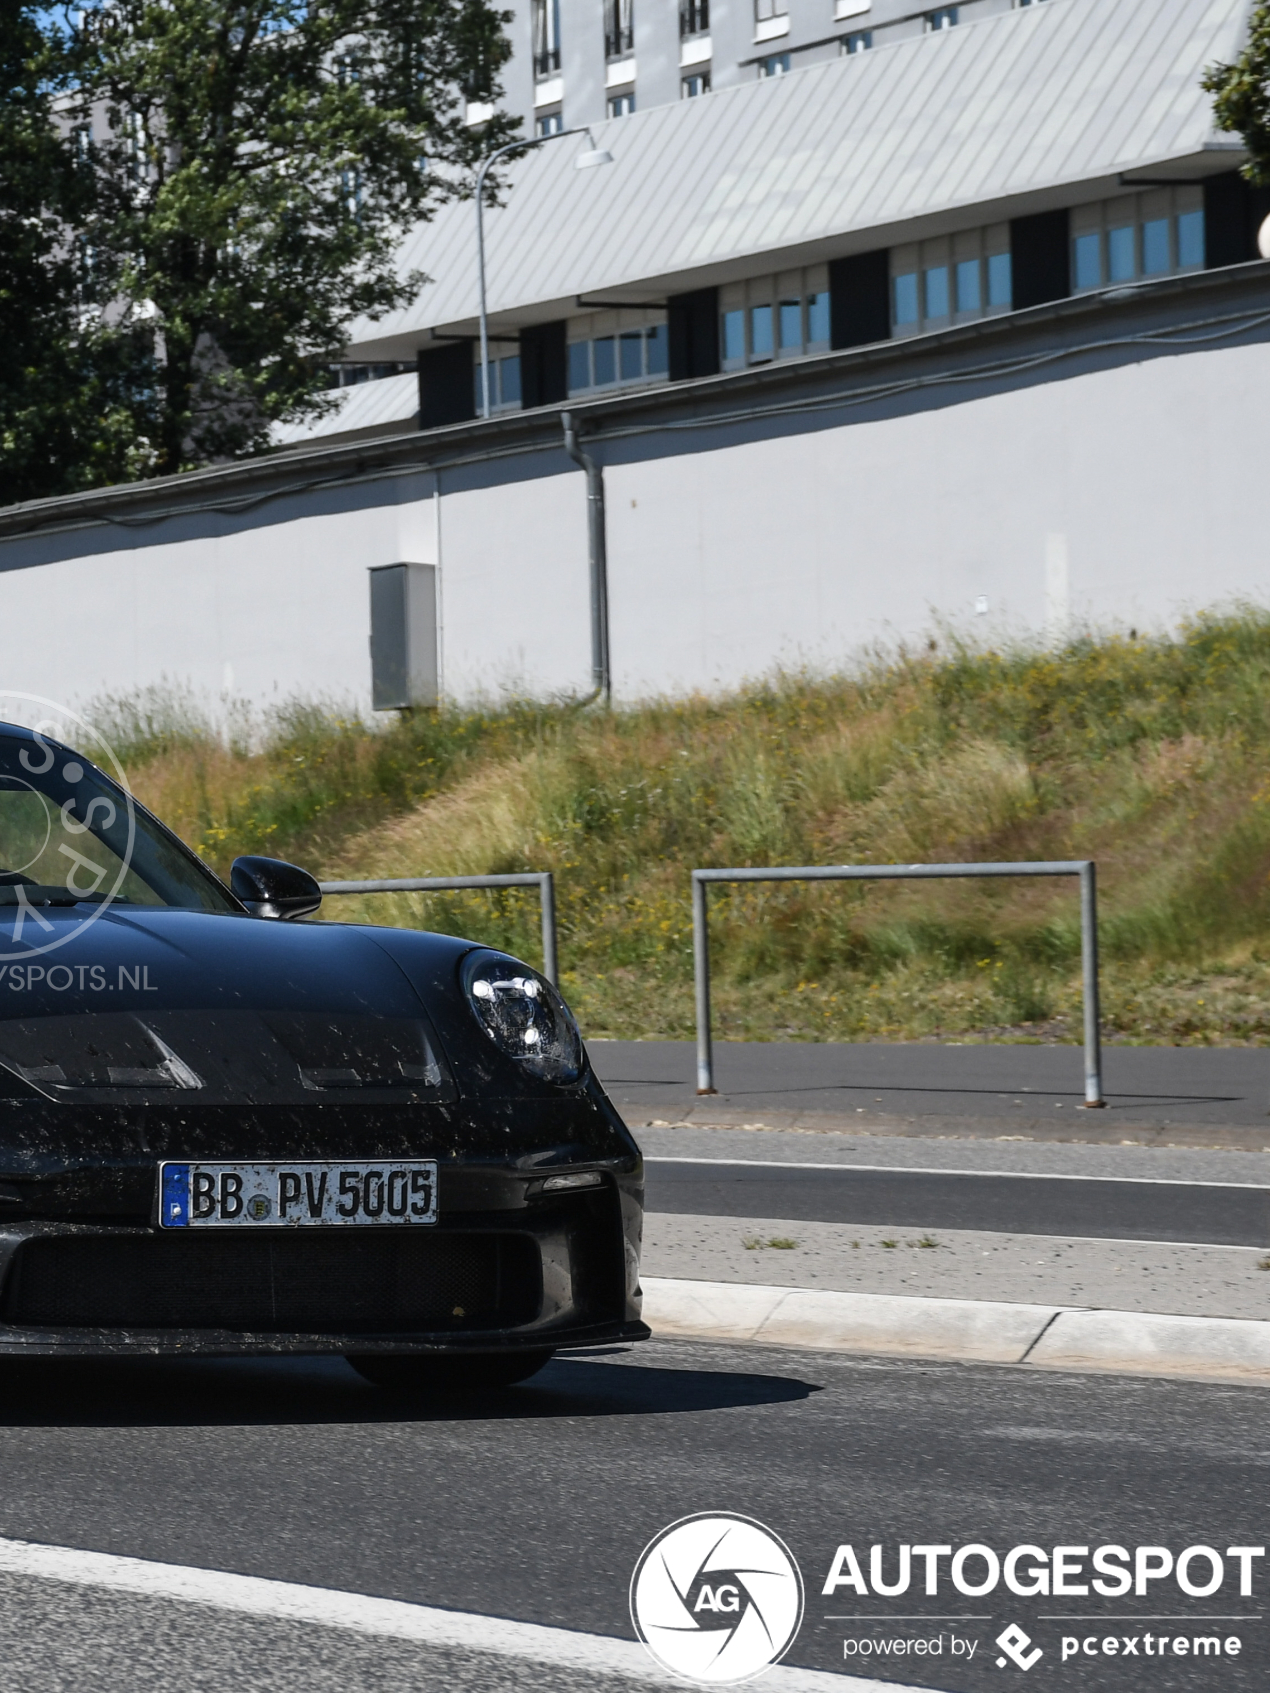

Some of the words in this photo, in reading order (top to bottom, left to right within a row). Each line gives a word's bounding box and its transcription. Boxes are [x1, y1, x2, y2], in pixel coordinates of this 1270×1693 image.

[191, 1172, 244, 1219] BB
[279, 1171, 329, 1218] PV
[338, 1170, 432, 1217] 5005
